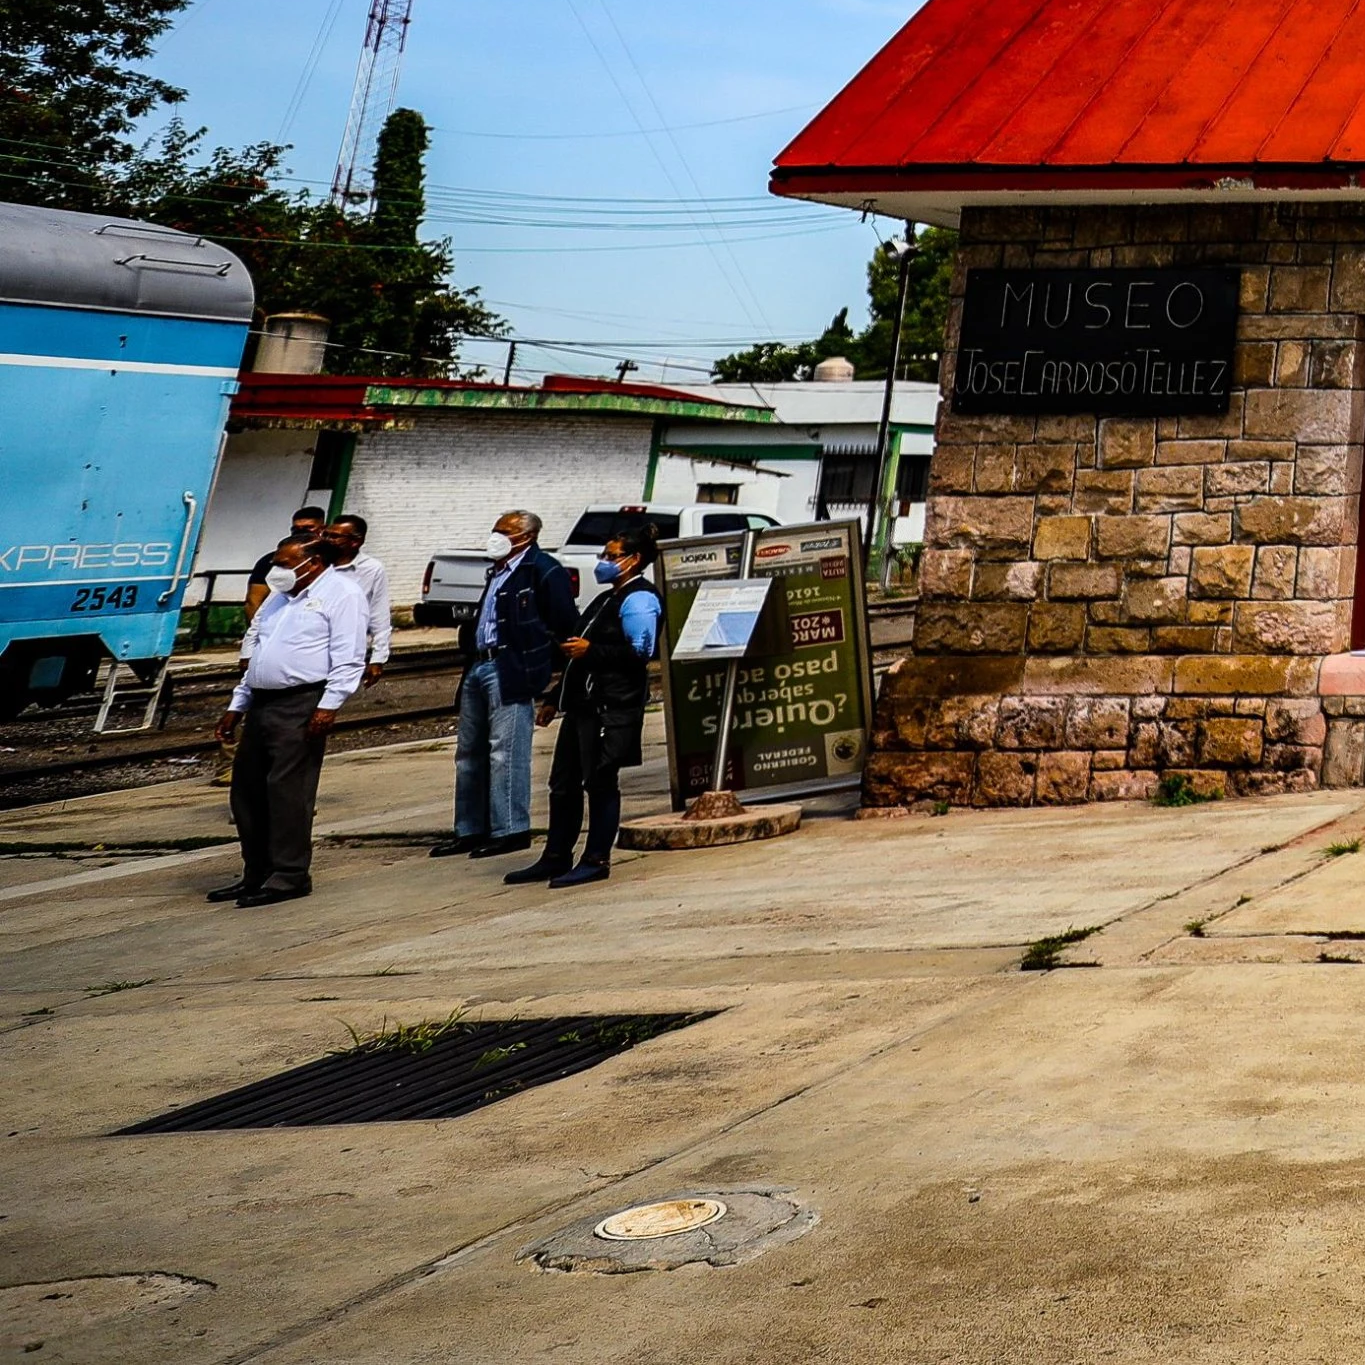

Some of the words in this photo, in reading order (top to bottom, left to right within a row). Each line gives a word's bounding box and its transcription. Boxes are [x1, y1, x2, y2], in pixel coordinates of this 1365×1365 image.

[1000, 282, 1204, 329] MUSEO
[70, 585, 139, 613] 2543
[786, 586, 821, 601] 1616
[791, 625, 836, 643] MARC
[774, 649, 838, 687] pasó
[758, 683, 814, 703] saber
[757, 745, 812, 761] FEDERAL
[753, 754, 817, 772] GOBIERNO
